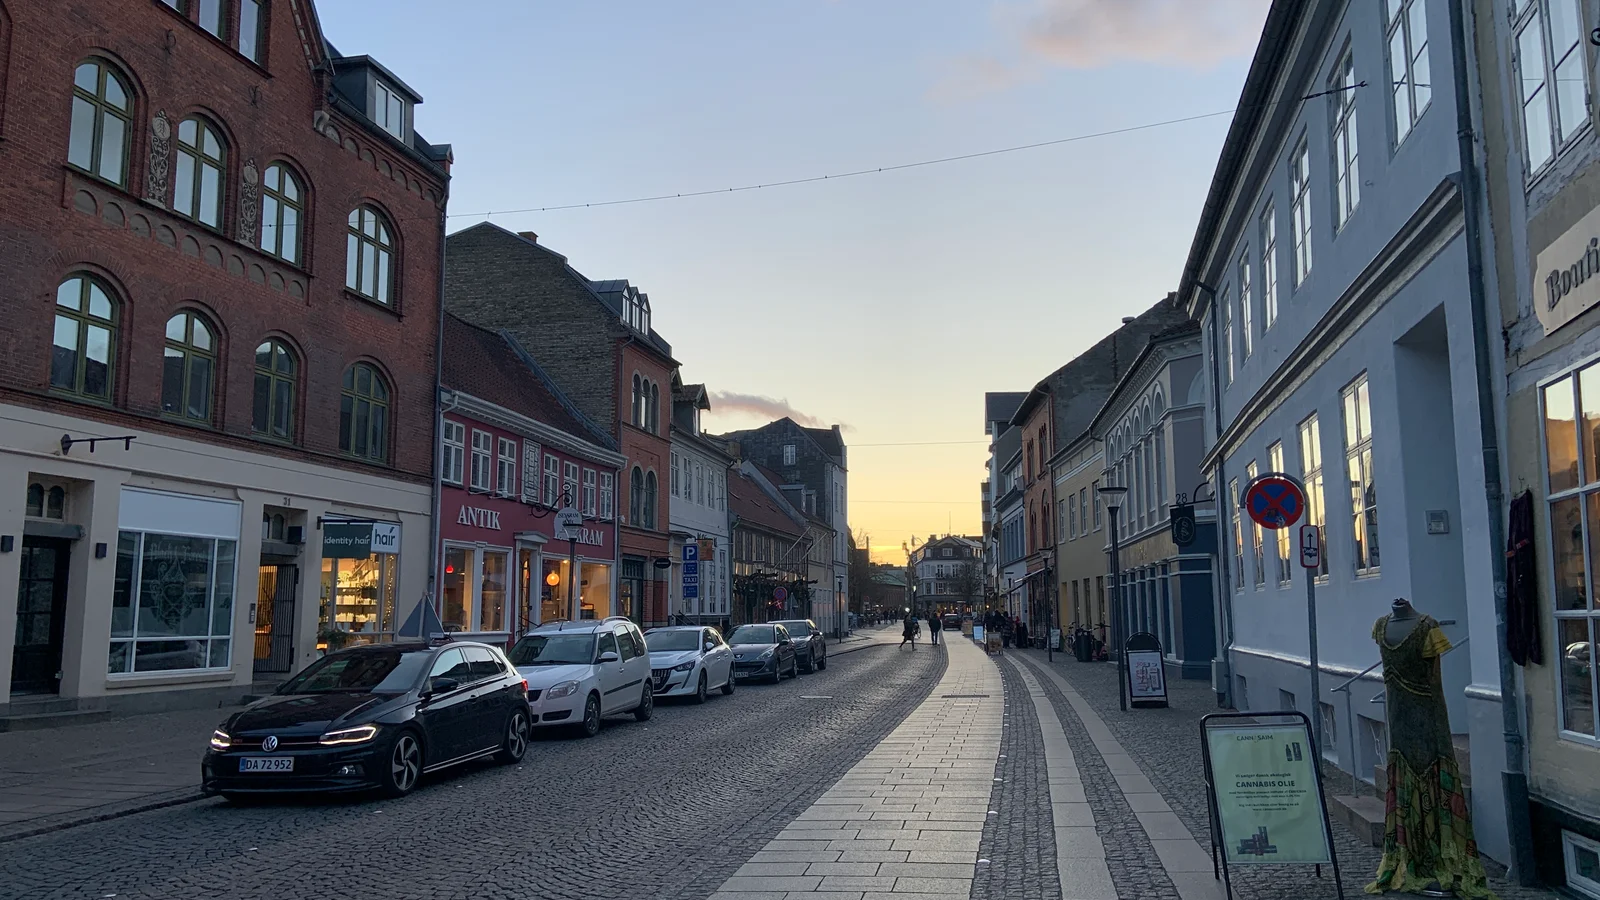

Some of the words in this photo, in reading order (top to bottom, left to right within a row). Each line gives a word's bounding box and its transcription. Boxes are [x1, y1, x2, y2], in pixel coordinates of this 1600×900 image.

[1545, 237, 1600, 312] Bouti
[283, 497, 291, 506] 31
[1176, 492, 1188, 505] 28
[456, 504, 502, 531] ANTIK
[324, 536, 353, 546] identity
[686, 547, 695, 560] P
[246, 759, 259, 770] DA
[261, 759, 273, 770] 72
[274, 759, 292, 770] 952
